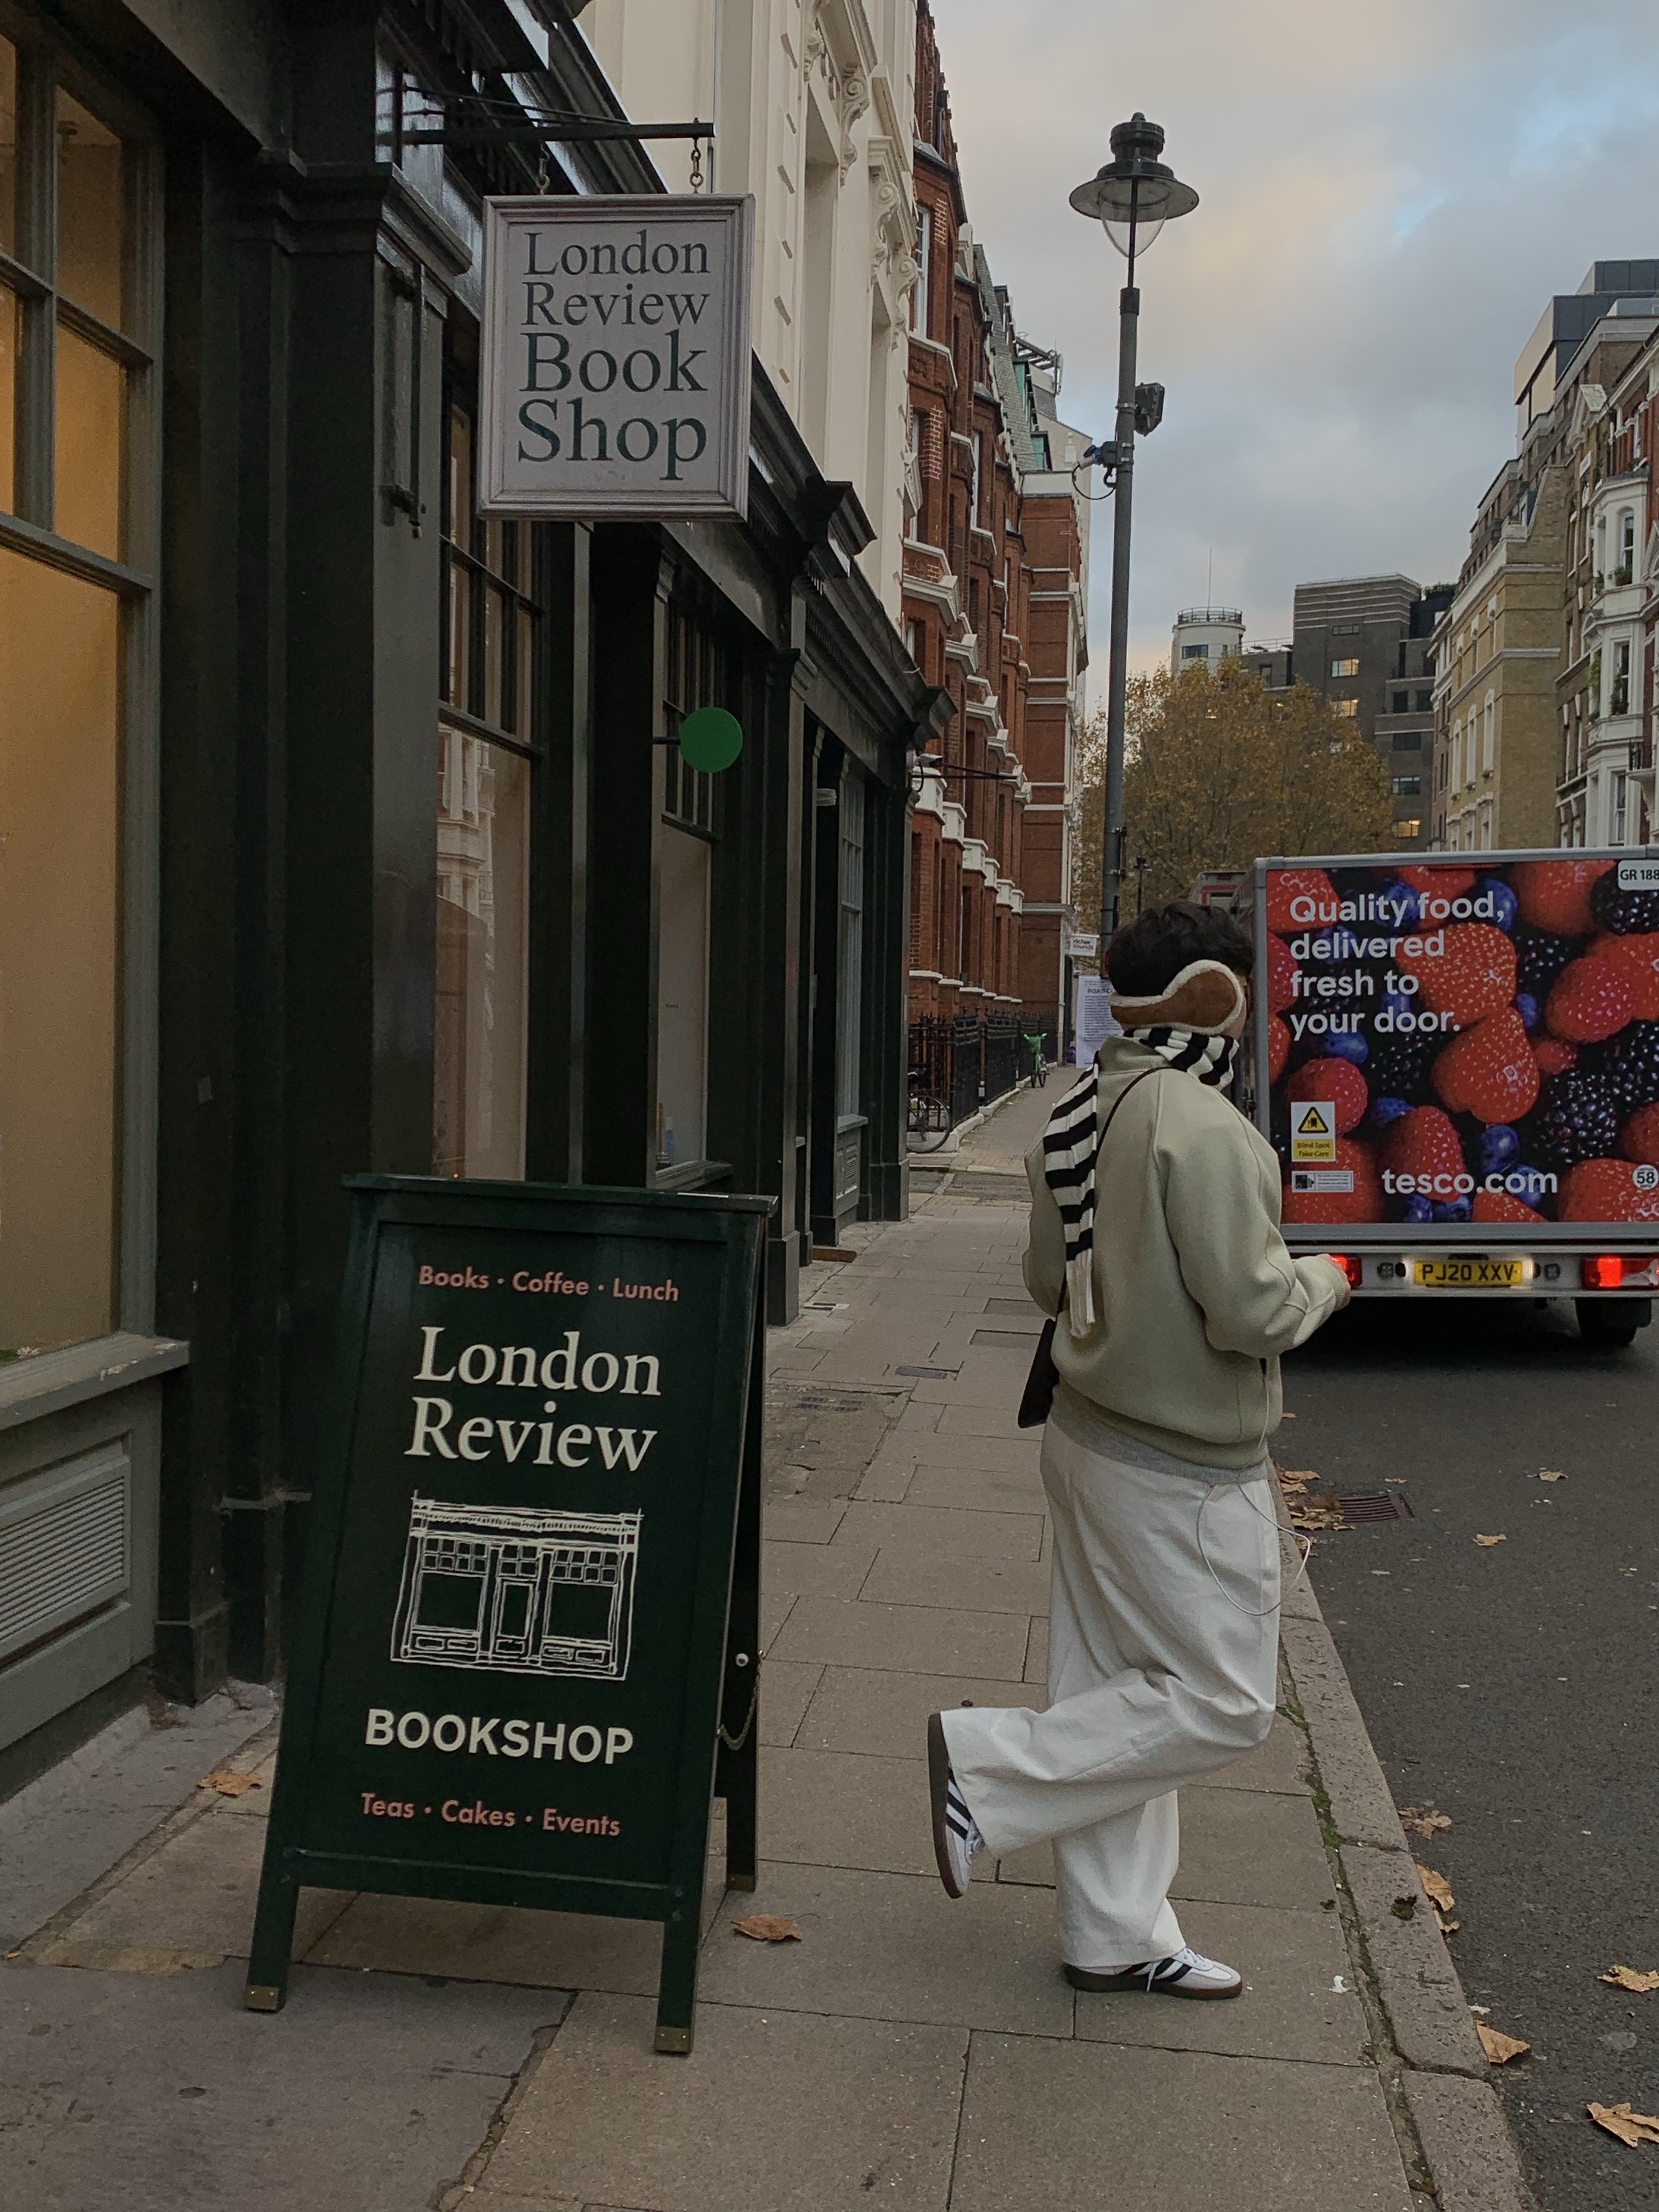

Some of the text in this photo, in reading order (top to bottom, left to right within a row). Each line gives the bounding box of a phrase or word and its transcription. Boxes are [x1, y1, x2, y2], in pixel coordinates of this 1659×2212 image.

[523, 228, 711, 275] London
[521, 281, 710, 326] Review
[519, 329, 708, 392] Book
[518, 396, 707, 481] Shop
[1620, 869, 1659, 881] GR 188
[1290, 891, 1505, 928] Quality food,
[1290, 929, 1445, 960] delivered
[1290, 969, 1419, 997] fresh to
[1289, 1006, 1461, 1042] your door.
[1381, 1169, 1558, 1194] tesco.com
[1637, 1171, 1655, 1184] 58
[418, 1265, 679, 1301] Books Coffee Lunch
[1422, 1262, 1515, 1281] PJ20 XXV
[413, 1326, 661, 1396] London
[404, 1396, 658, 1472] Review
[365, 1708, 634, 1764] BOOKSHOP
[361, 1792, 621, 1836] Teas Cakes Events
